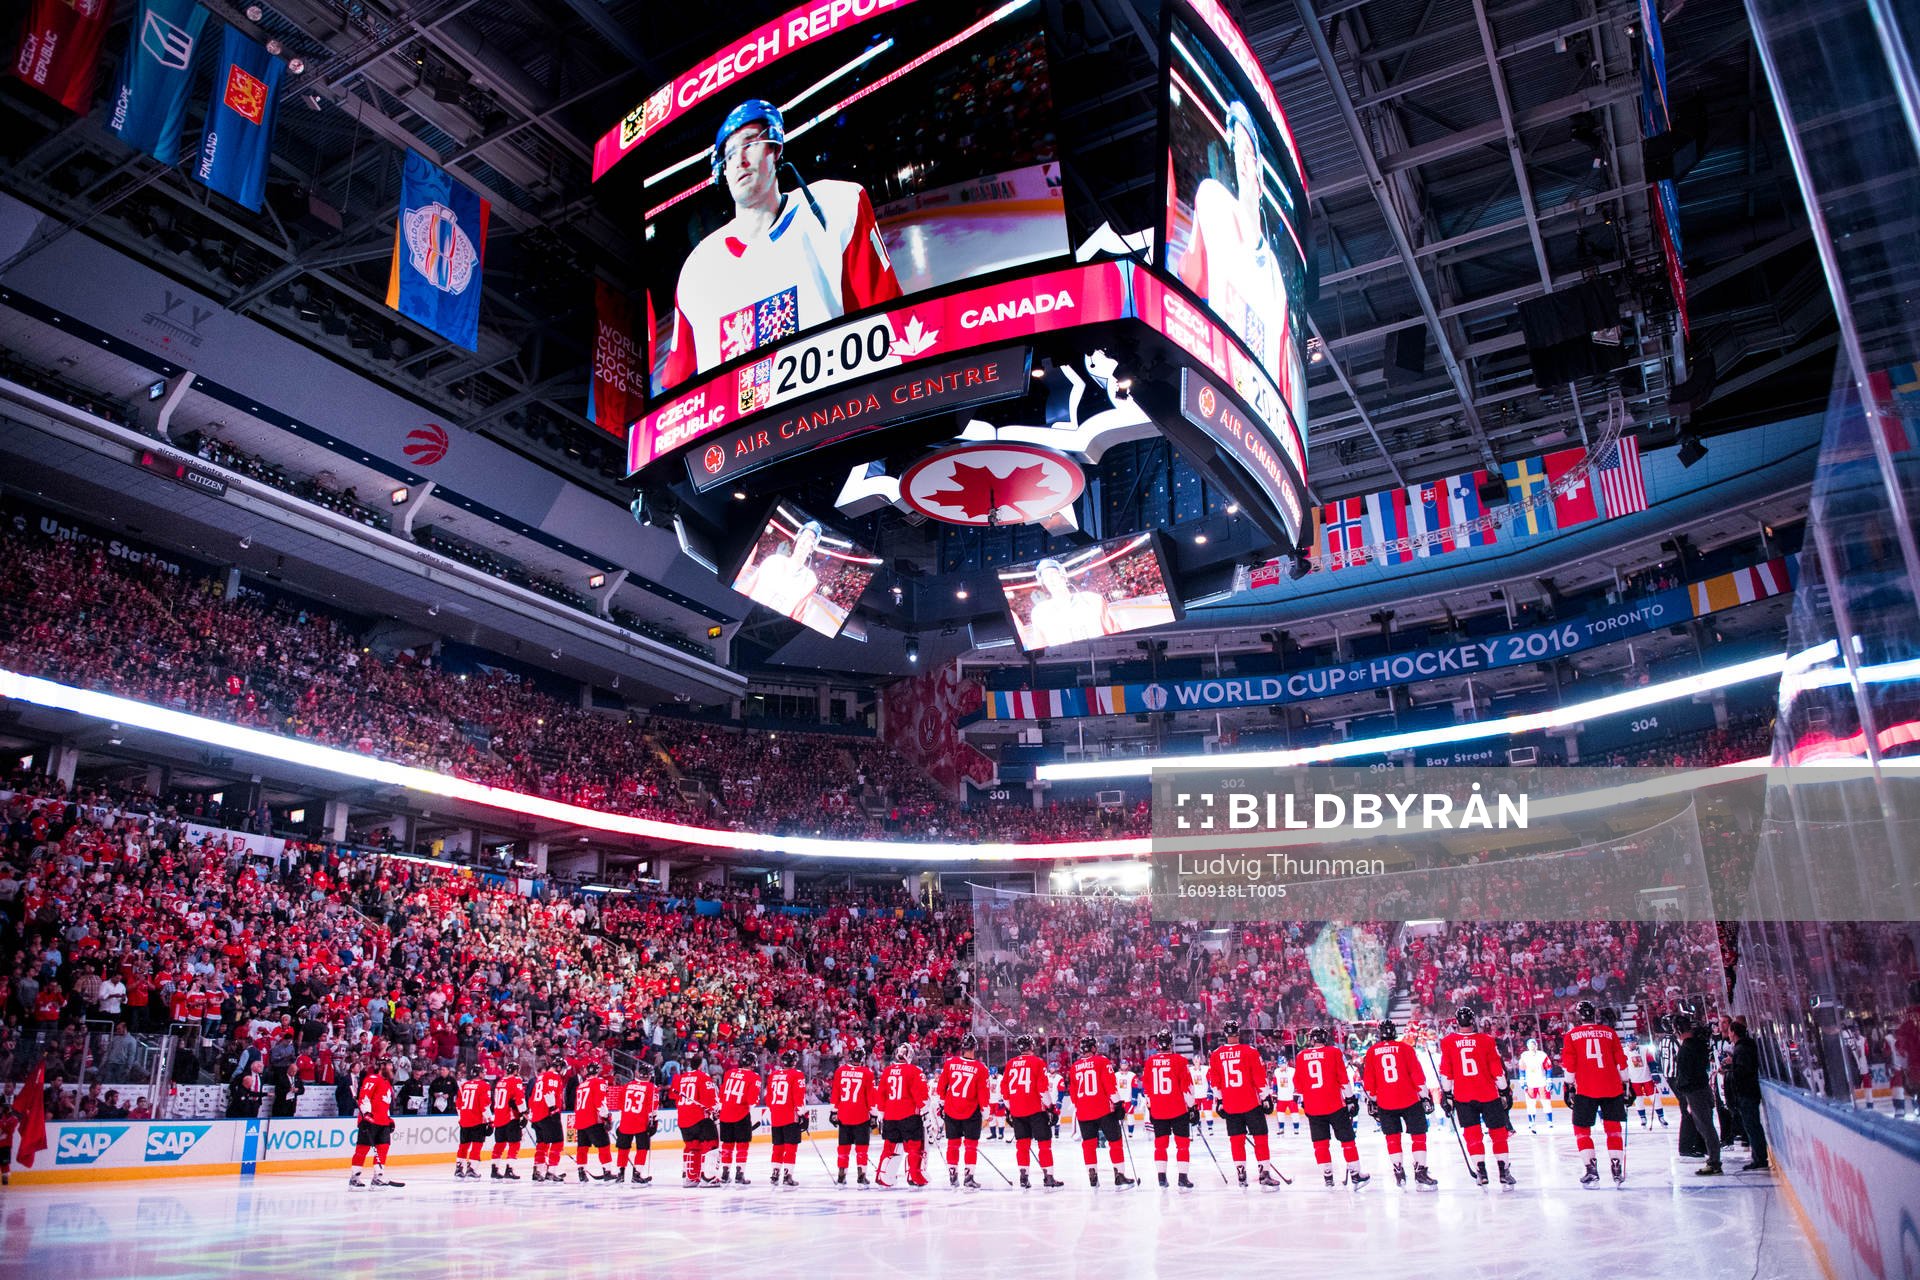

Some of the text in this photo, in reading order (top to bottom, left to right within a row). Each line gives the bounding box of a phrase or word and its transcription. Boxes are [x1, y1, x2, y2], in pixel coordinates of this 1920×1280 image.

[18, 33, 39, 75] CZECH
[33, 30, 58, 85] REPUBLIC
[677, 28, 780, 107] CZECH
[111, 85, 132, 131] EUROPE
[200, 132, 218, 179] FINLAND
[959, 290, 1075, 329] CANADA
[1163, 293, 1210, 343] CZECH
[598, 336, 626, 359] CUP
[776, 324, 891, 395] 20:00
[1165, 316, 1227, 378] REPUBLIC
[595, 363, 626, 392] 2016
[596, 348, 643, 388] HOCKE
[656, 392, 705, 431] CZECH
[735, 362, 1000, 458] AIR CANADA CENTRE
[655, 405, 725, 453] REPUBLIC
[1220, 408, 1243, 440] AIR
[1244, 432, 1282, 488] CANADA
[157, 447, 242, 485] aircanadacentre.com
[188, 472, 224, 491] CITIZEN
[1174, 604, 1664, 705] WORLD CUP OF HOCKEY 2016 TORONTO
[1631, 717, 1658, 732] 304
[1369, 762, 1395, 774] 303
[1426, 750, 1494, 768] Bay Street
[989, 790, 1010, 800] 301
[1221, 778, 1246, 789] 302
[1455, 1039, 1477, 1048] WEBER
[1571, 1030, 1612, 1041] BOUWMEESTER
[1152, 1058, 1171, 1066] TOEWS
[1460, 1047, 1478, 1077] 6
[1586, 1039, 1604, 1068] 4
[1008, 1067, 1031, 1095] 24
[1152, 1067, 1172, 1095] 16
[1222, 1060, 1243, 1088] 15
[1308, 1060, 1323, 1089] 9
[1382, 1053, 1399, 1083] 8
[678, 1083, 697, 1105] 50
[724, 1079, 746, 1104] 44
[840, 1078, 862, 1103] 37
[887, 1075, 903, 1100] 31
[951, 1071, 974, 1098] 27
[1075, 1069, 1098, 1098] 20
[461, 1089, 475, 1110] 91
[624, 1090, 645, 1114] 63
[58, 1133, 112, 1159] SAP
[147, 1131, 195, 1157] SAP
[263, 1130, 344, 1150] WORLD
[392, 1126, 459, 1144] OF HOCK
